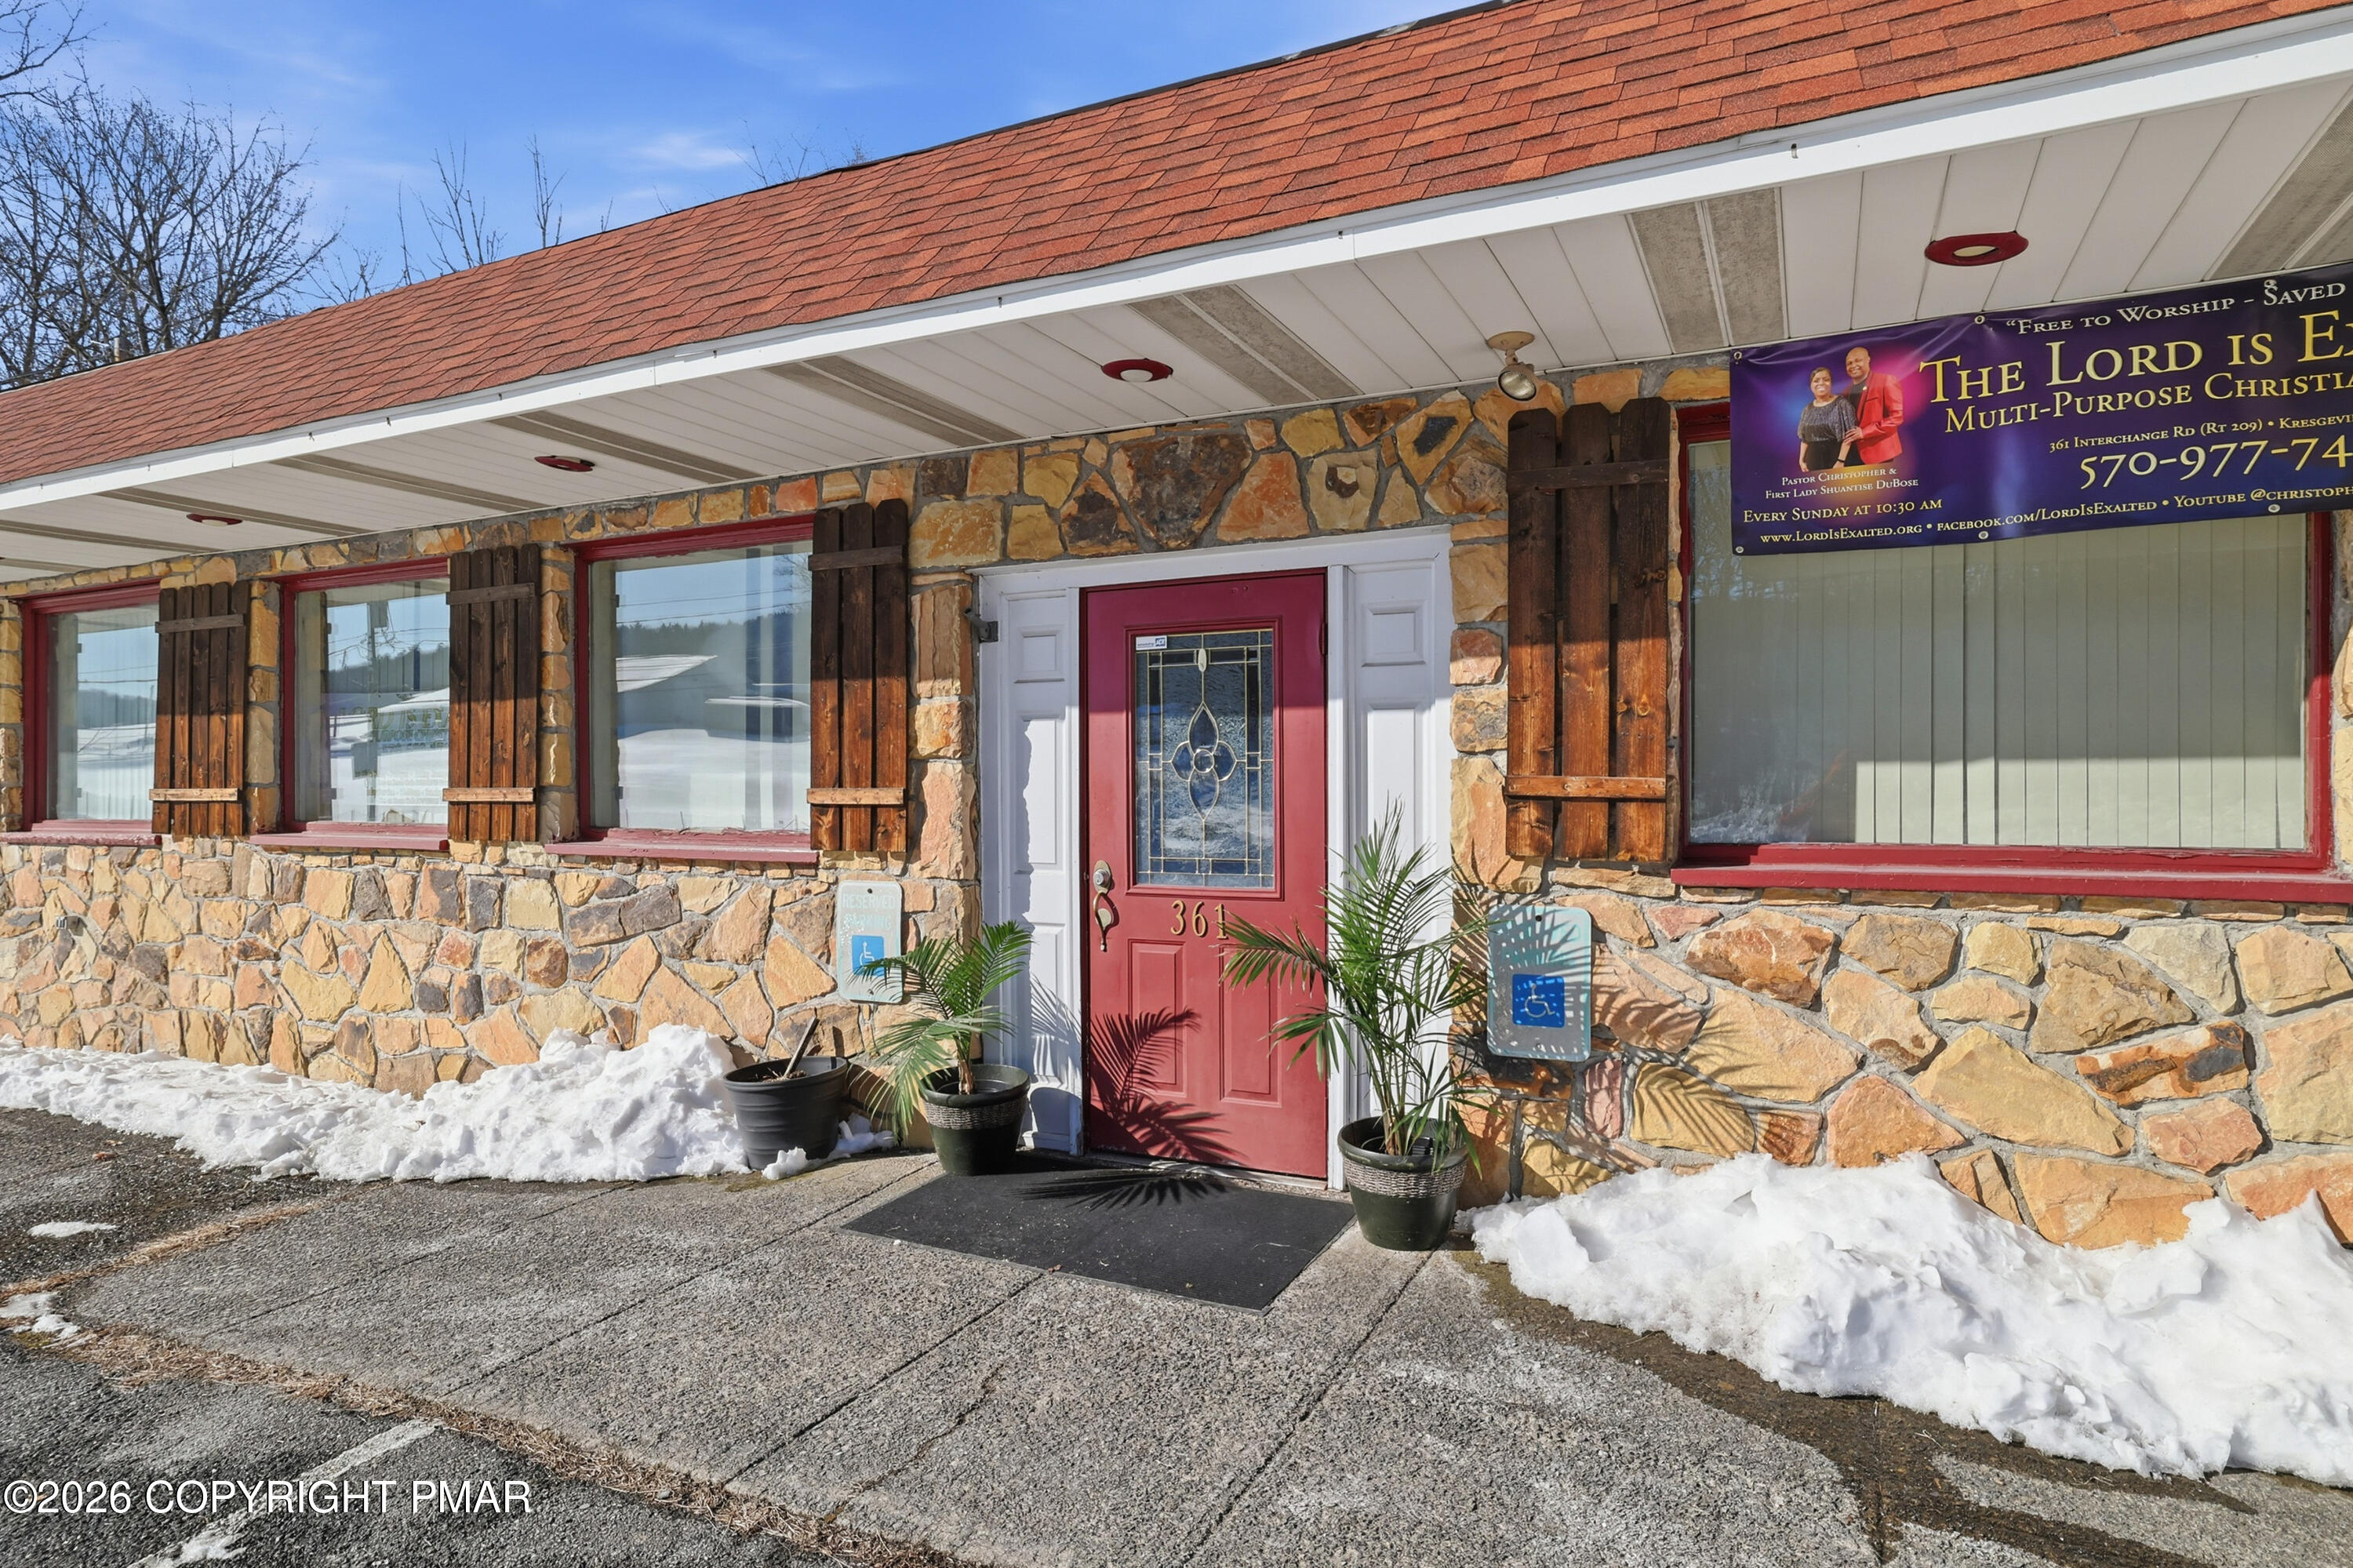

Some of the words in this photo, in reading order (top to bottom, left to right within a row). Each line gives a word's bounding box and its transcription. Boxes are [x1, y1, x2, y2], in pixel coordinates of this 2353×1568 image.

[2080, 315, 2111, 327] TO
[2116, 297, 2235, 322] WORSHIP
[2263, 282, 2347, 306] SAVED
[1918, 355, 2026, 403] THE
[2046, 340, 2203, 387] LORD
[2227, 333, 2274, 366] IS
[2297, 310, 2353, 362] E
[1945, 384, 2193, 433] MULTI-PURPOSE
[2049, 438, 2070, 453] 361
[2075, 430, 2169, 448] INTERCHANGE
[2173, 426, 2195, 438] RD
[2200, 422, 2226, 436] (RT
[2231, 419, 2264, 432] 209)
[1781, 475, 1816, 486] PASTOR
[1818, 468, 1886, 482] CHRISTOPHER
[2080, 434, 2353, 489] 570-977-74
[1766, 489, 1791, 500] FIRST
[1793, 488, 1818, 498] LADY
[1820, 482, 1873, 496] SHUANTISE
[1876, 478, 1919, 490] DUBOSE
[1743, 509, 1788, 523] EVERY
[1791, 506, 1849, 522] SUNDAY
[1854, 504, 1871, 515] AT
[1876, 501, 1915, 516] 10:30
[1919, 499, 1943, 511] AM
[1760, 524, 1922, 544] WWW.LORDISEXALTED.ORG
[1937, 501, 2158, 532] FACEBOOK.COM/LORDISEXALTED
[2173, 493, 2246, 508] YOUTUBE
[842, 893, 896, 908] RESERVED
[1170, 900, 1227, 939] 361
